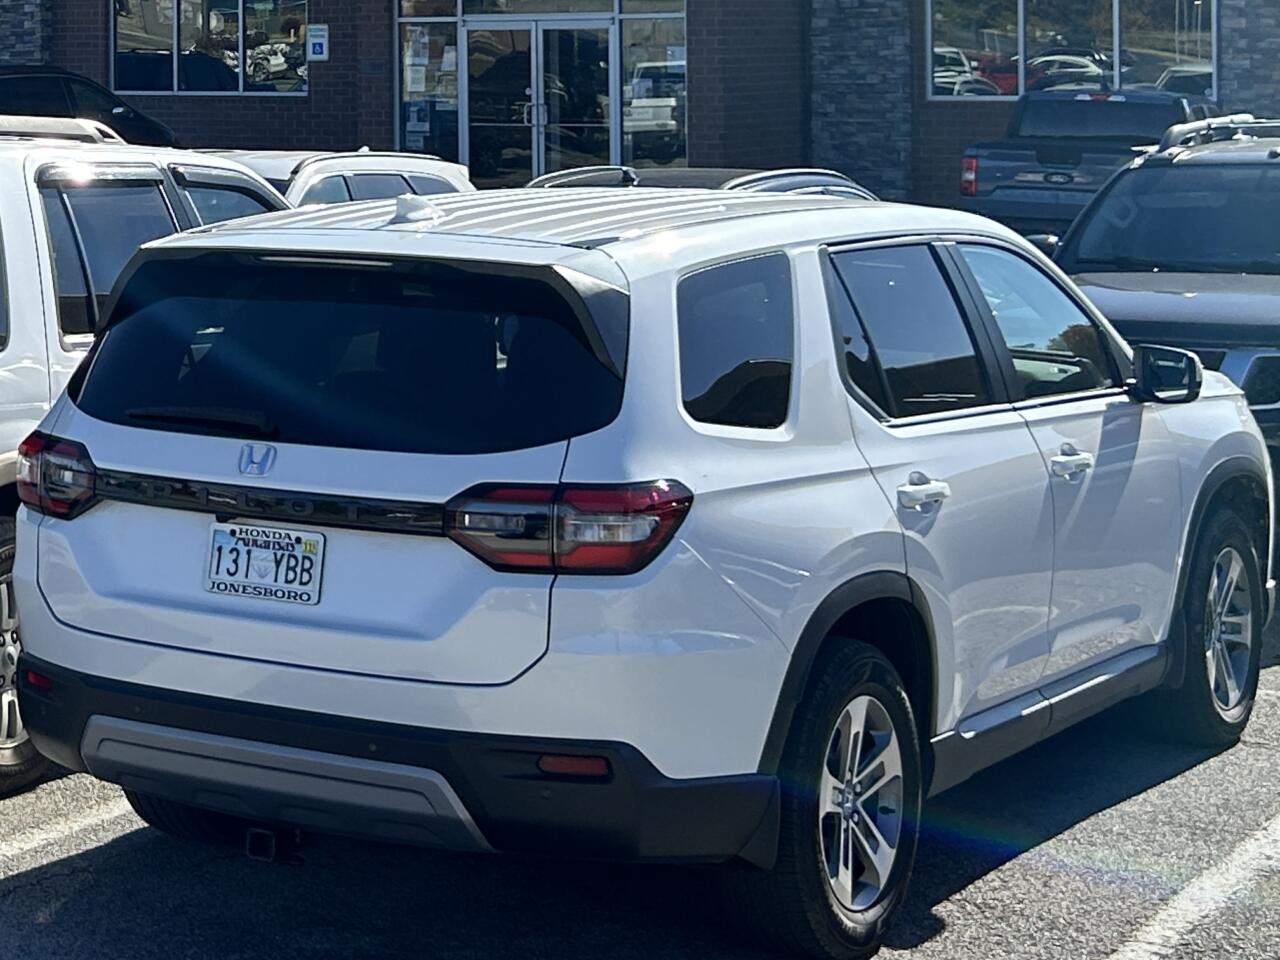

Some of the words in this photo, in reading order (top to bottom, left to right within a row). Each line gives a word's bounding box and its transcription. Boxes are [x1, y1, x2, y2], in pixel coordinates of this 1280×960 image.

[145, 481, 363, 521] PILOT
[238, 527, 293, 542] HONDA
[215, 545, 252, 579] 131
[273, 551, 314, 586] YBB
[209, 581, 312, 603] JONESBORO
